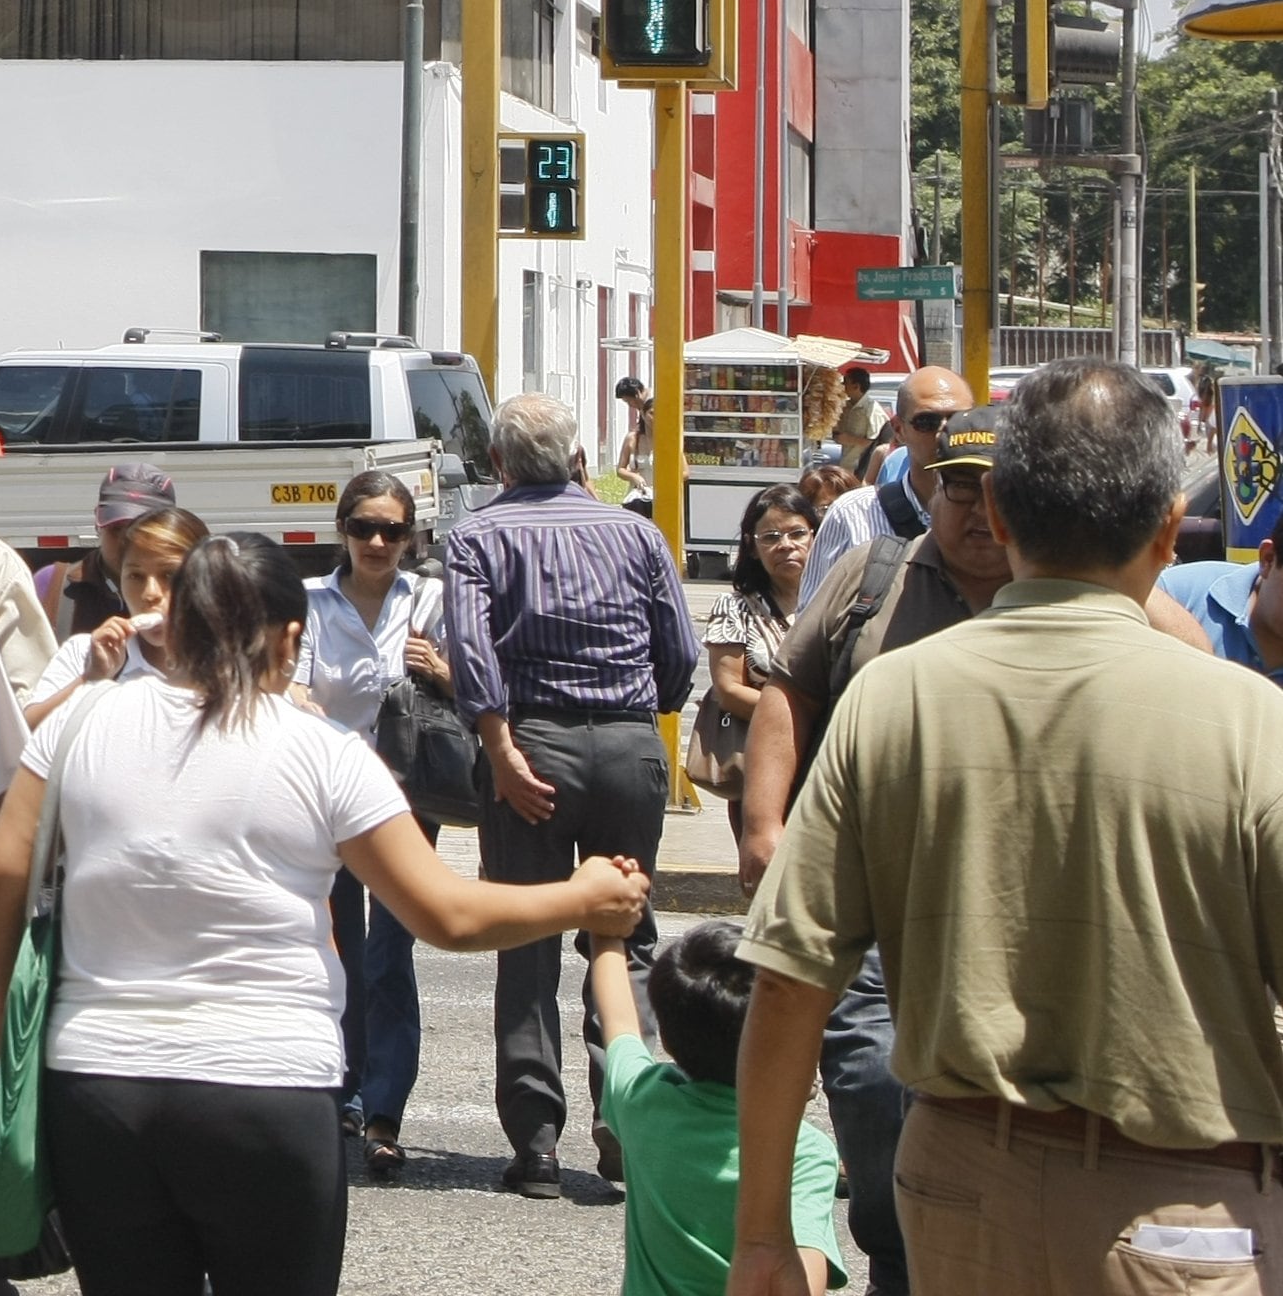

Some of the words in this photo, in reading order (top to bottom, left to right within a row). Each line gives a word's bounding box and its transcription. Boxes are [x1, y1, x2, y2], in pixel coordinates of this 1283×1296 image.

[538, 146, 570, 179] 23
[873, 271, 900, 282] Javier
[902, 270, 930, 281] Prado
[931, 269, 952, 281] Este
[902, 287, 931, 296] Cuadra
